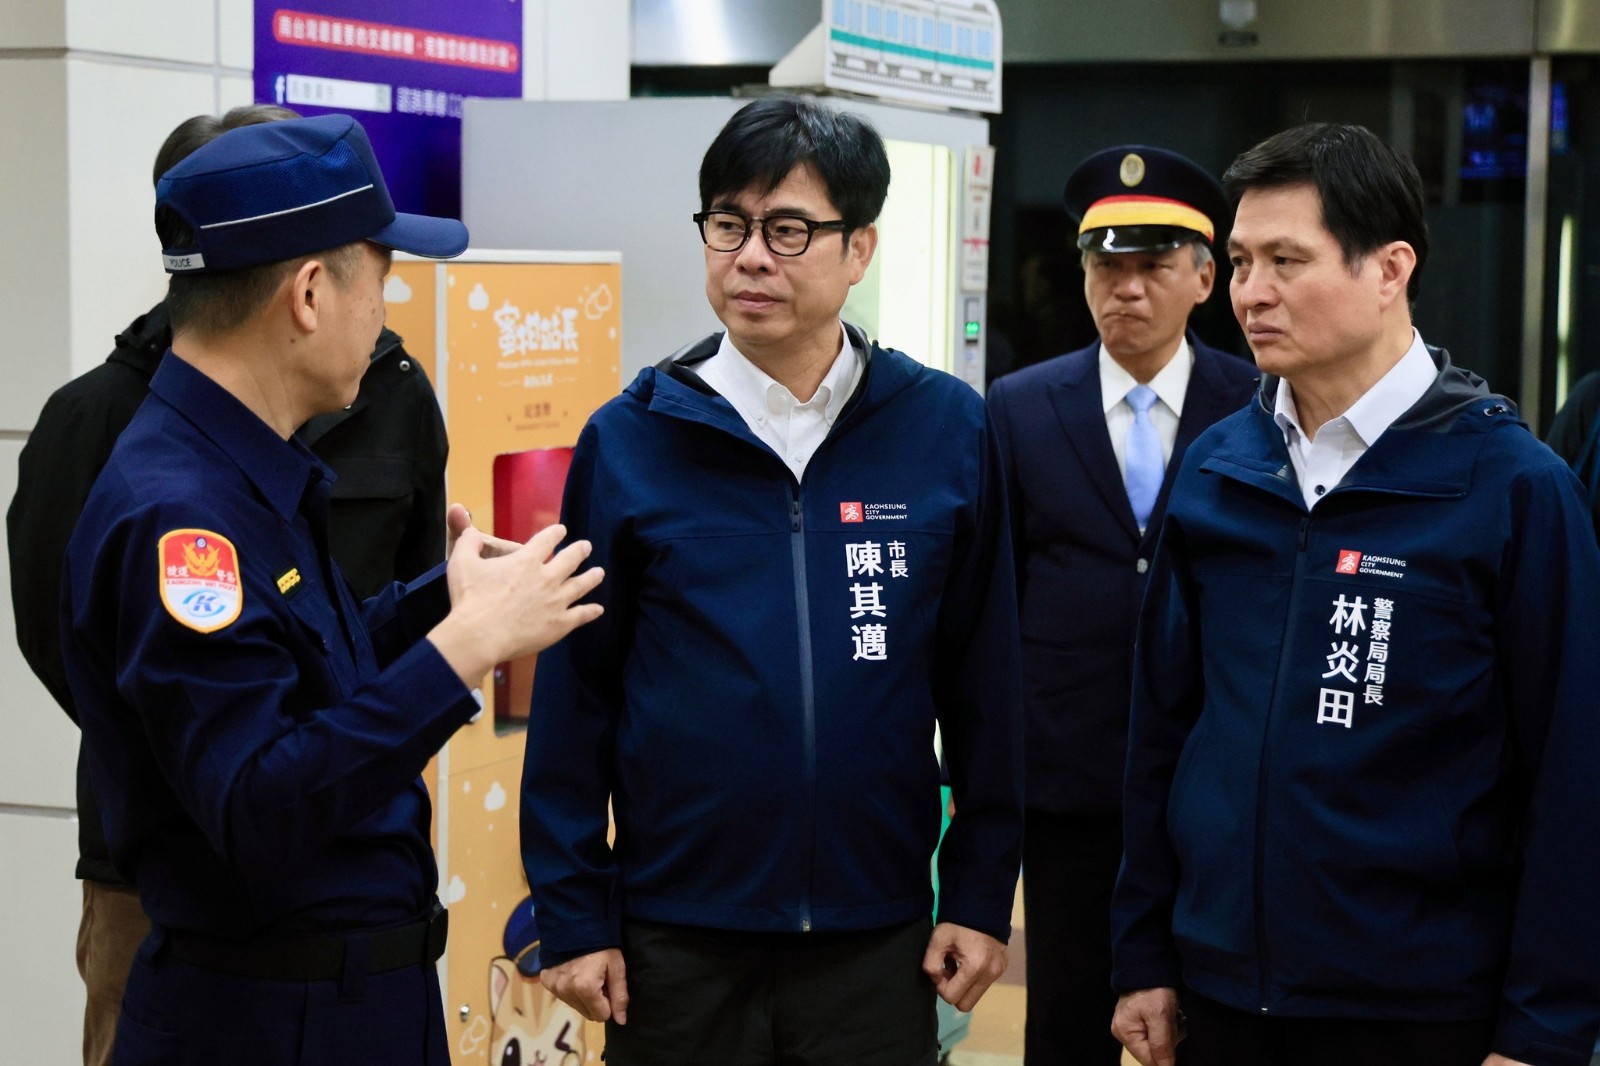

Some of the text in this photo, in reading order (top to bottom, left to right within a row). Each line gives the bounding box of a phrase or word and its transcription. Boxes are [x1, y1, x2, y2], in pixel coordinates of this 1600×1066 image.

[169, 258, 191, 267] POLICE
[887, 540, 909, 578] 市長
[1359, 567, 1404, 579] GOVERNMENT
[1362, 555, 1406, 567] KAOHSIUNG
[845, 540, 887, 661] 陳其邁
[1316, 594, 1368, 729] 林炎田
[1363, 598, 1394, 706] 警察局局長
